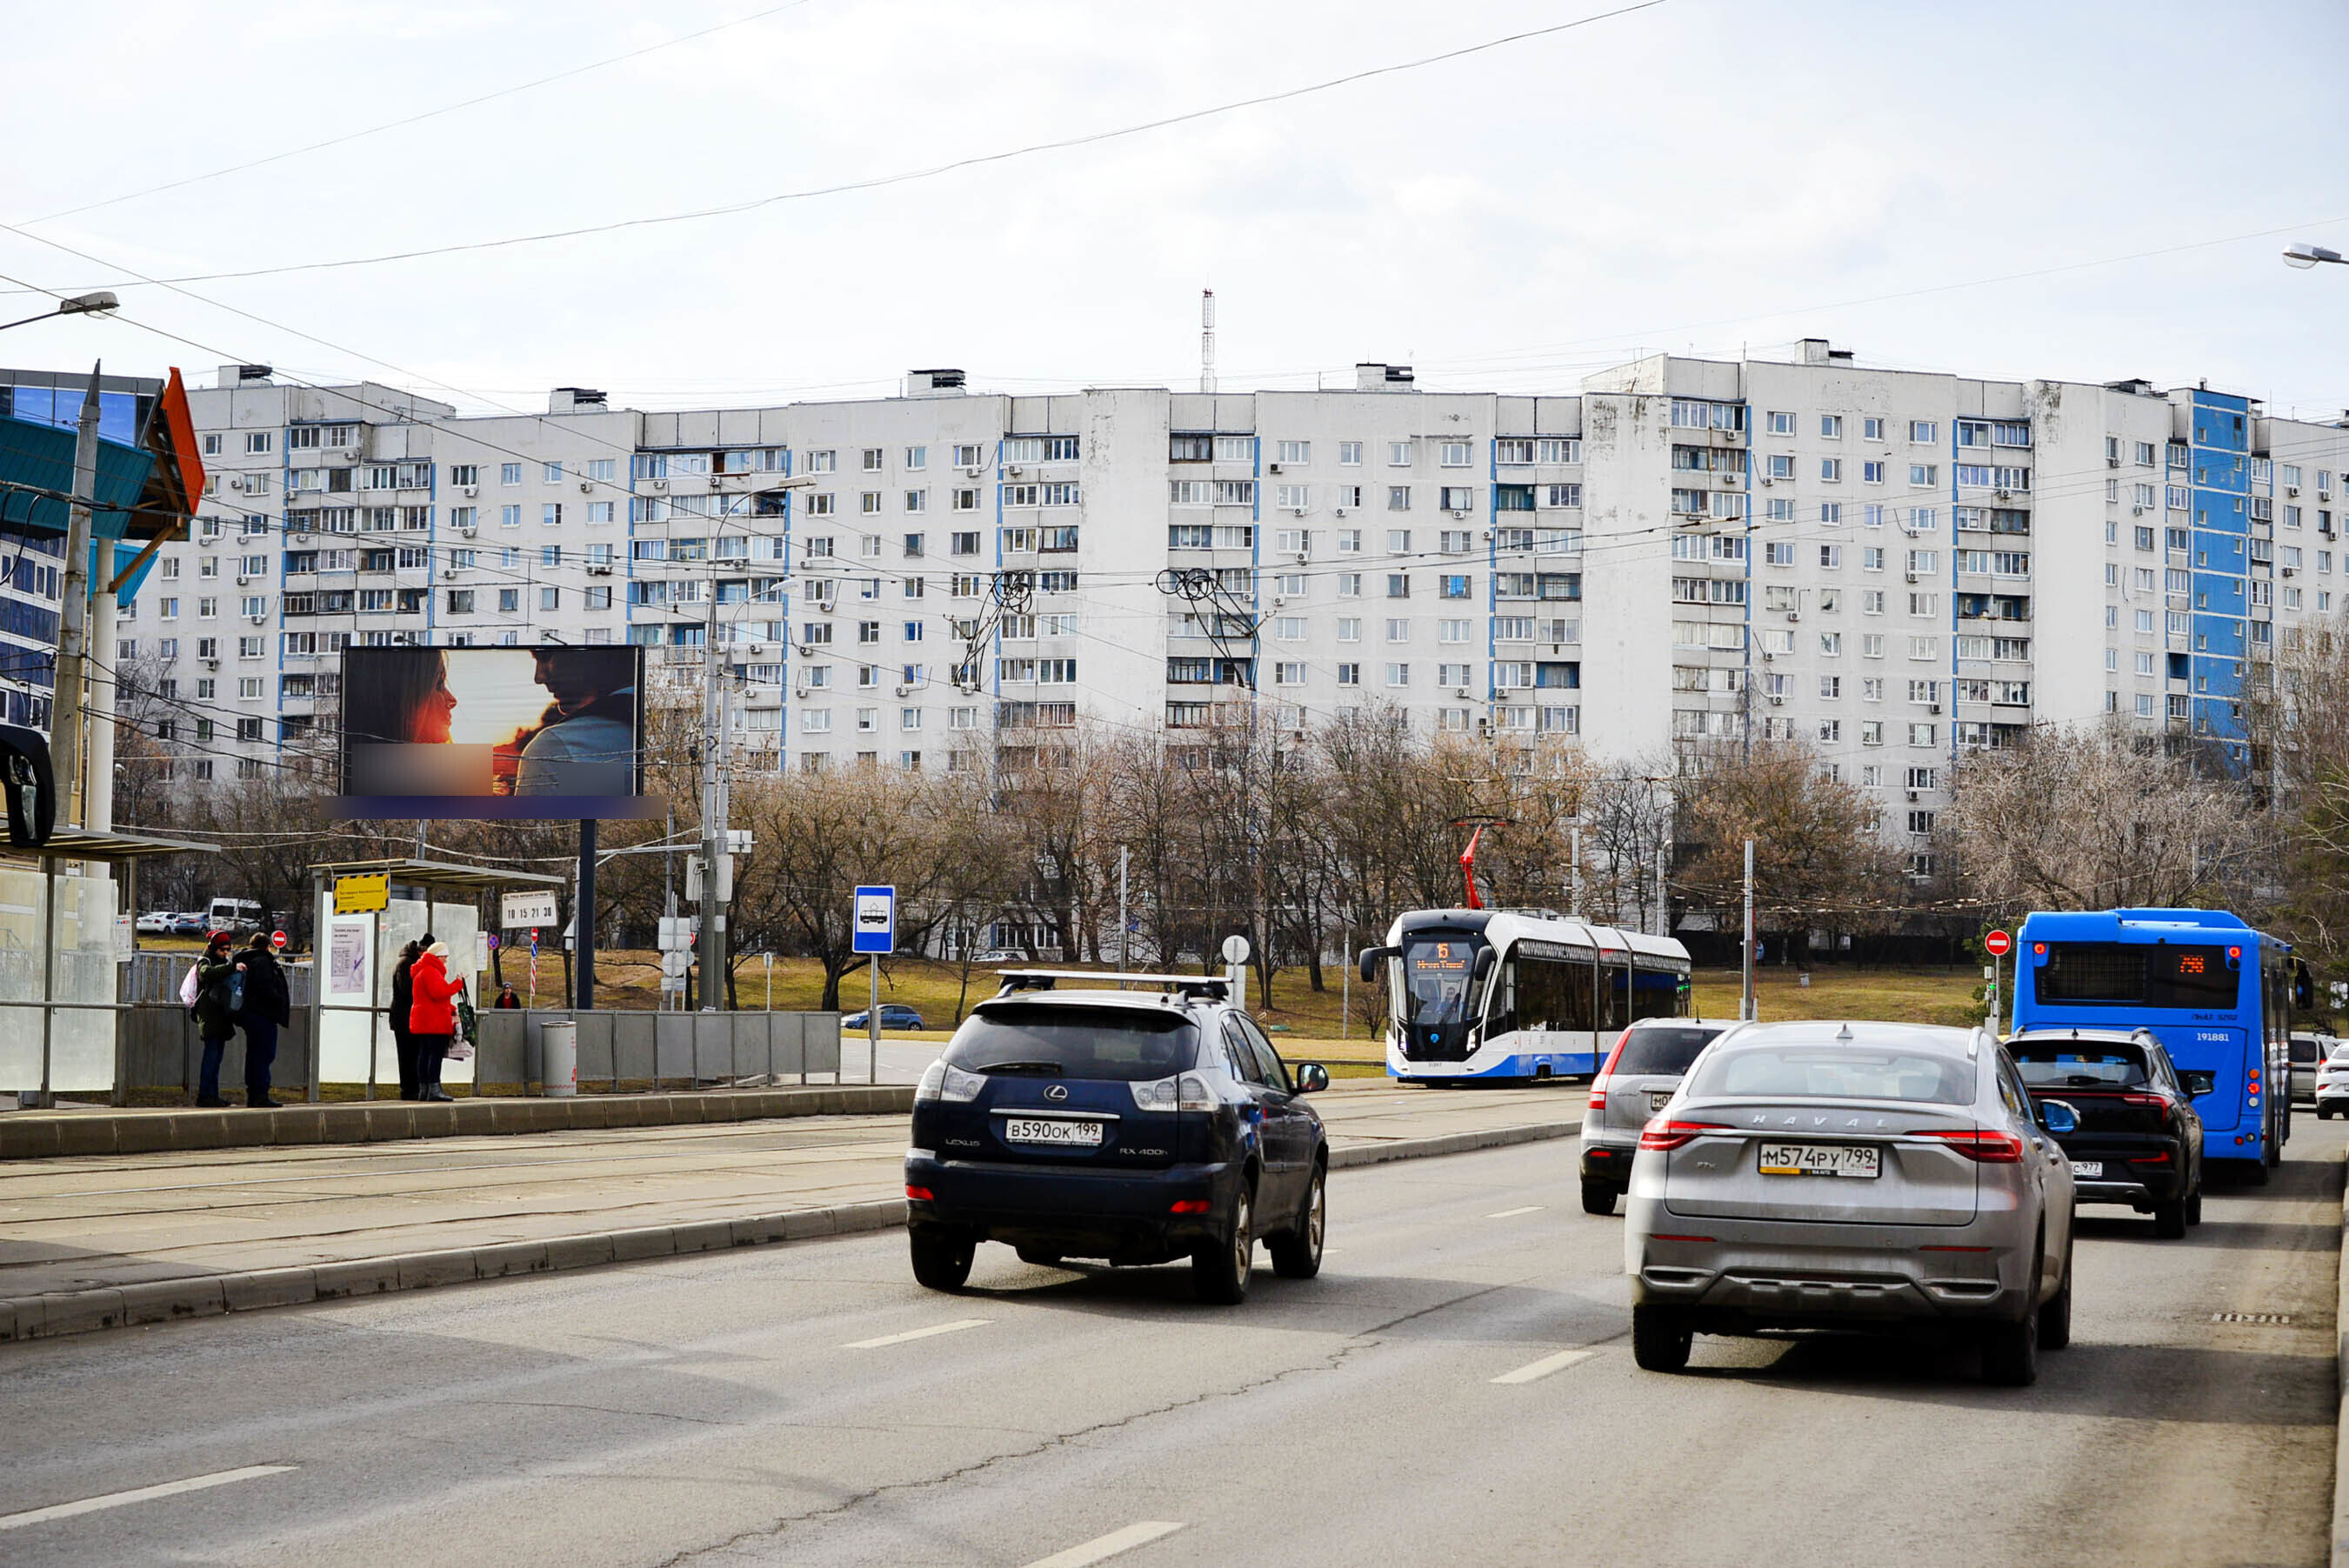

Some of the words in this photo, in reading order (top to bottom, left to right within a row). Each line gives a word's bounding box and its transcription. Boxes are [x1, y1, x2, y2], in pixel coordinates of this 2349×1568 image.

[519, 908, 528, 919] 15
[531, 907, 539, 917] 21
[2196, 1032, 2230, 1042] 191881
[1752, 1115, 1887, 1129] HAVAL
[1076, 1124, 1098, 1136] 199
[945, 1138, 982, 1147] LEXUS
[1845, 1148, 1873, 1164] 799
[2082, 1162, 2099, 1171] 977
